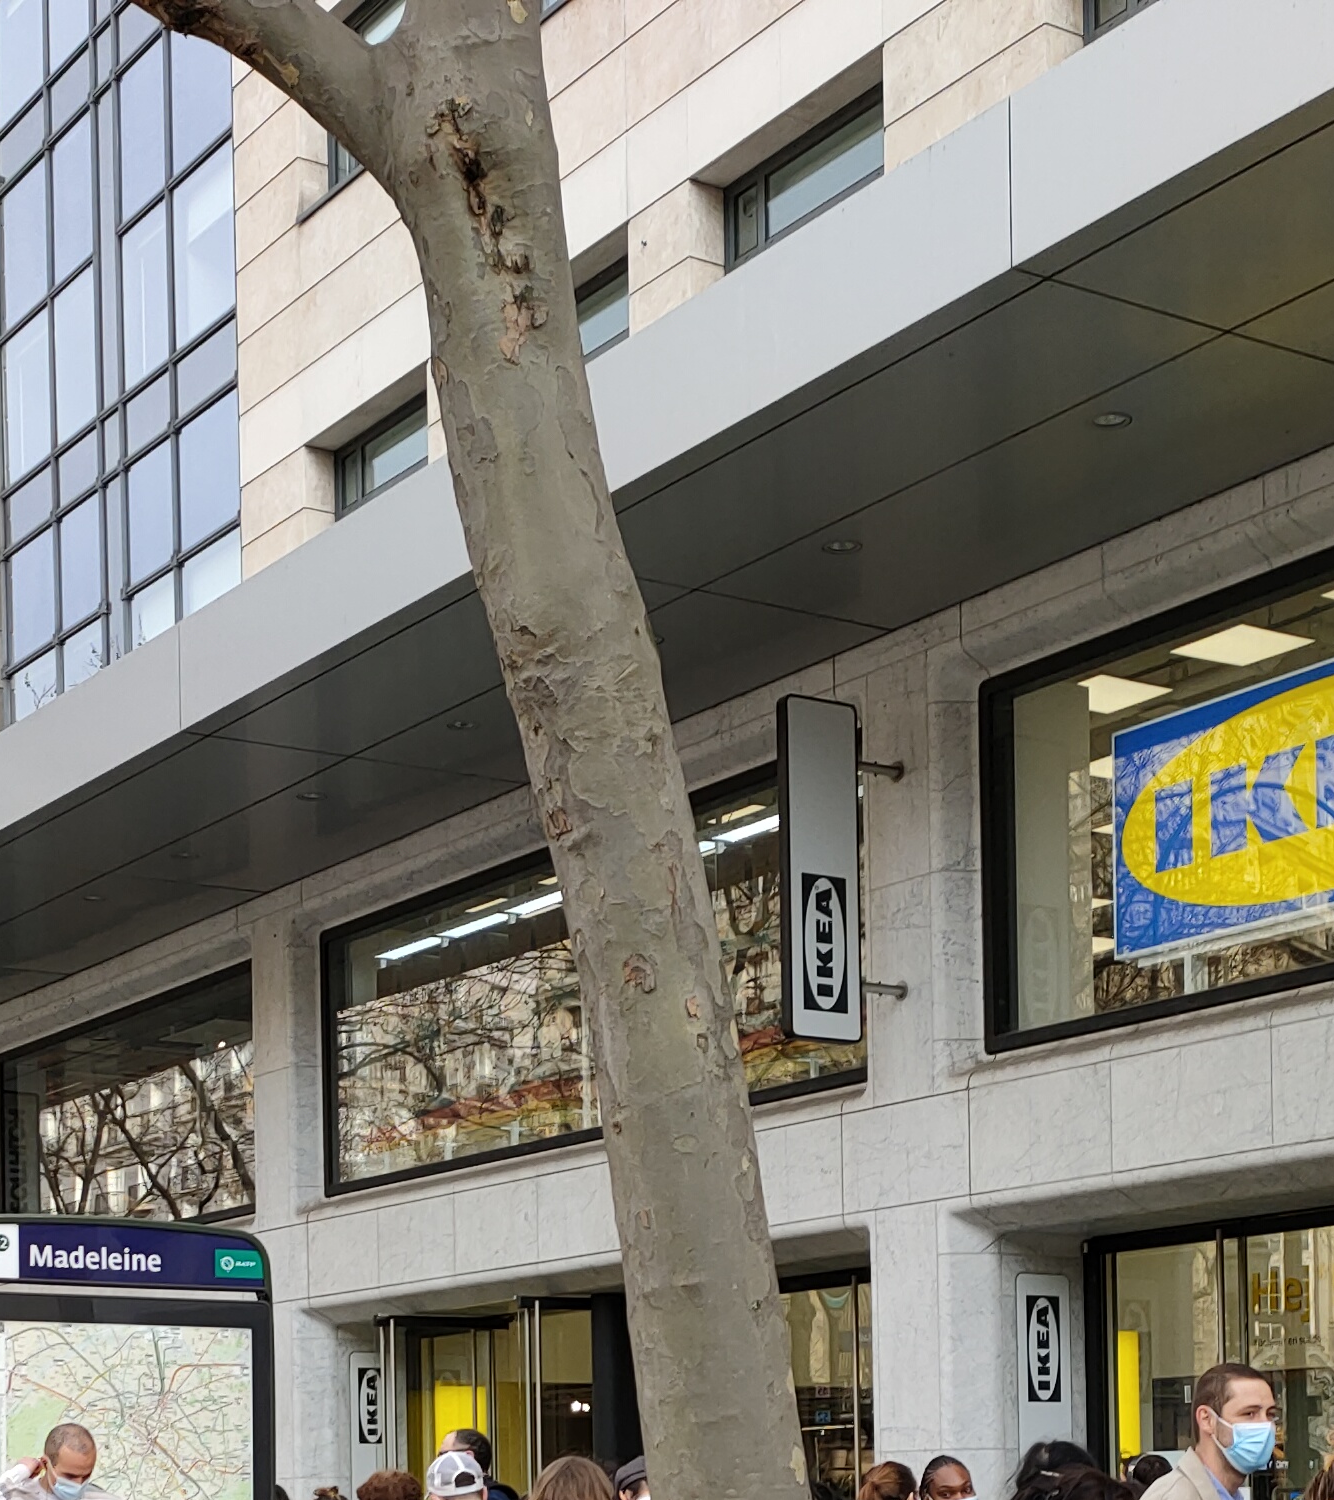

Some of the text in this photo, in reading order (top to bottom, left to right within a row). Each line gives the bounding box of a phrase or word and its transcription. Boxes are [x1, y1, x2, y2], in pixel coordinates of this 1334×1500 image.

[814, 887, 834, 998] IKEA
[29, 1244, 162, 1272] Madeleine
[1036, 1304, 1051, 1391] IKEA
[367, 1375, 378, 1436] IKEA
